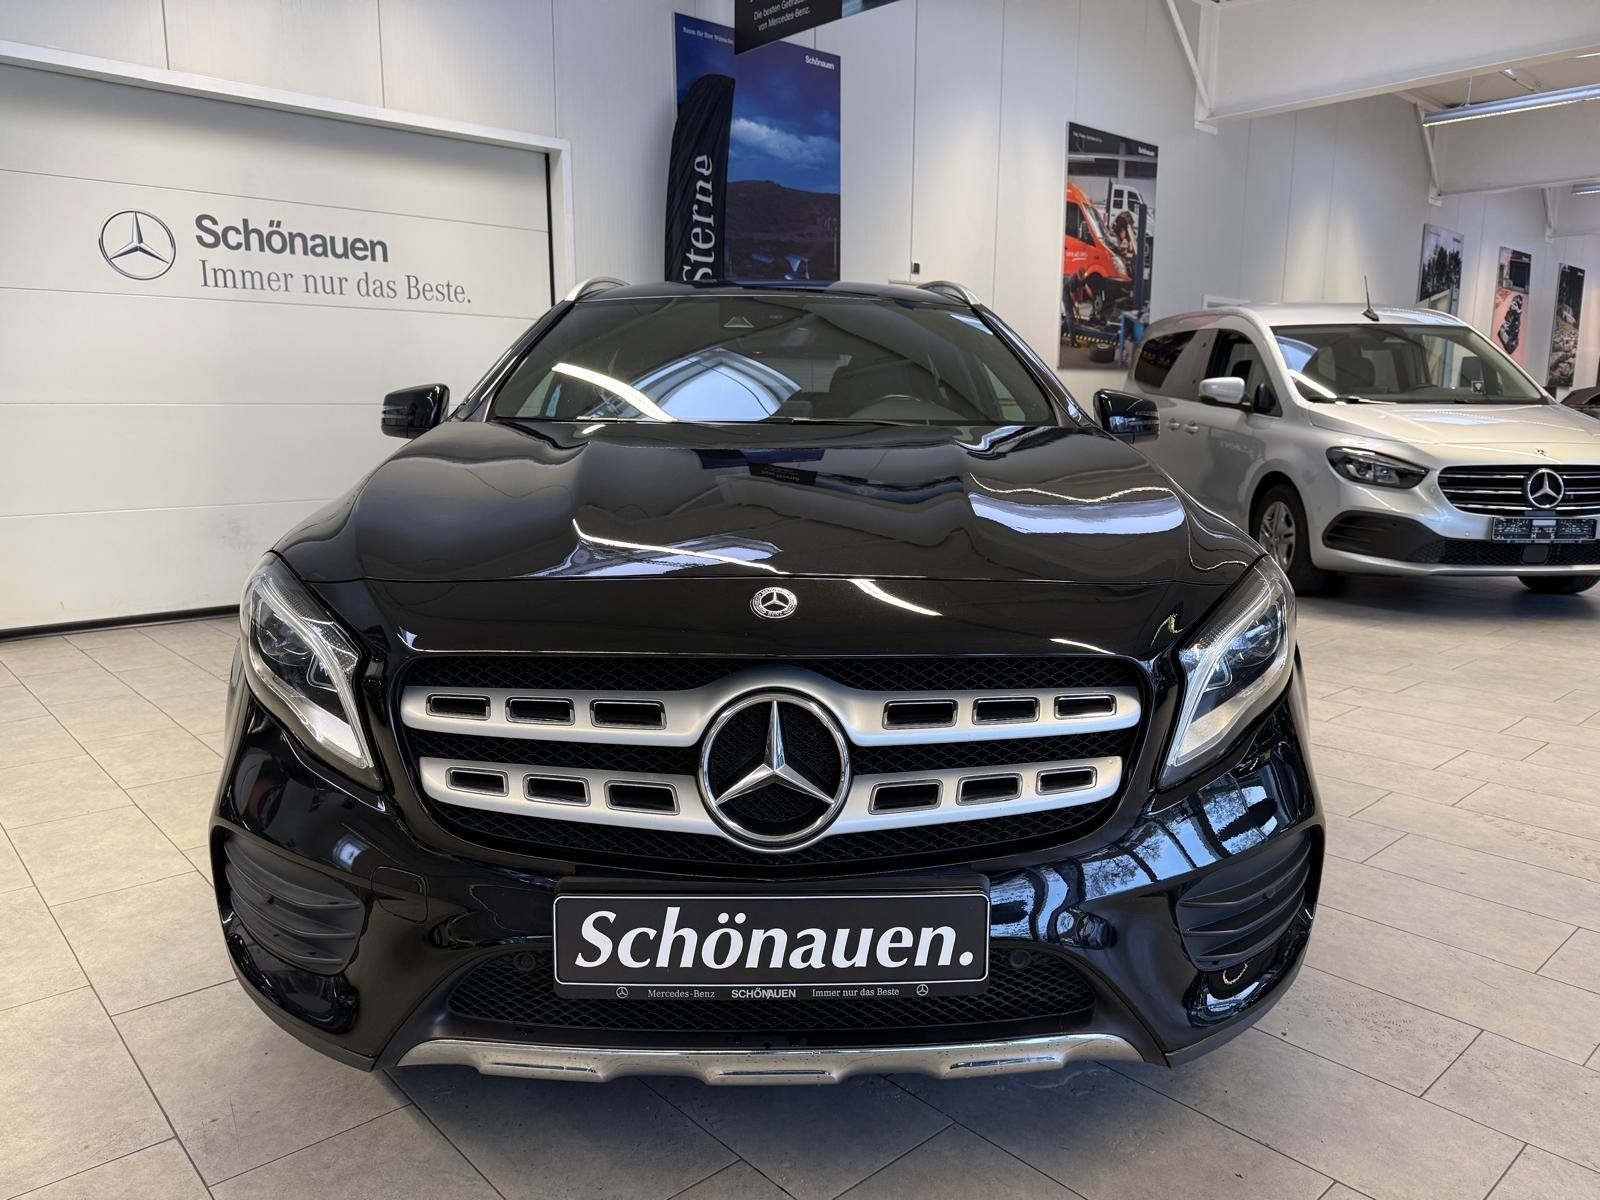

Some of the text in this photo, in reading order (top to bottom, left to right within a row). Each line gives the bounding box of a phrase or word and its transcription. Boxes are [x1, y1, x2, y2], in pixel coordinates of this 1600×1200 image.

[805, 55, 835, 70] Schönauen
[194, 213, 389, 263] Schönauen
[198, 258, 473, 304] Immer nur das Beste.
[574, 905, 974, 970] Schönauen.
[647, 986, 900, 999] Mercedes-Benz SCHÖNAUEN Immer nur das Beste
